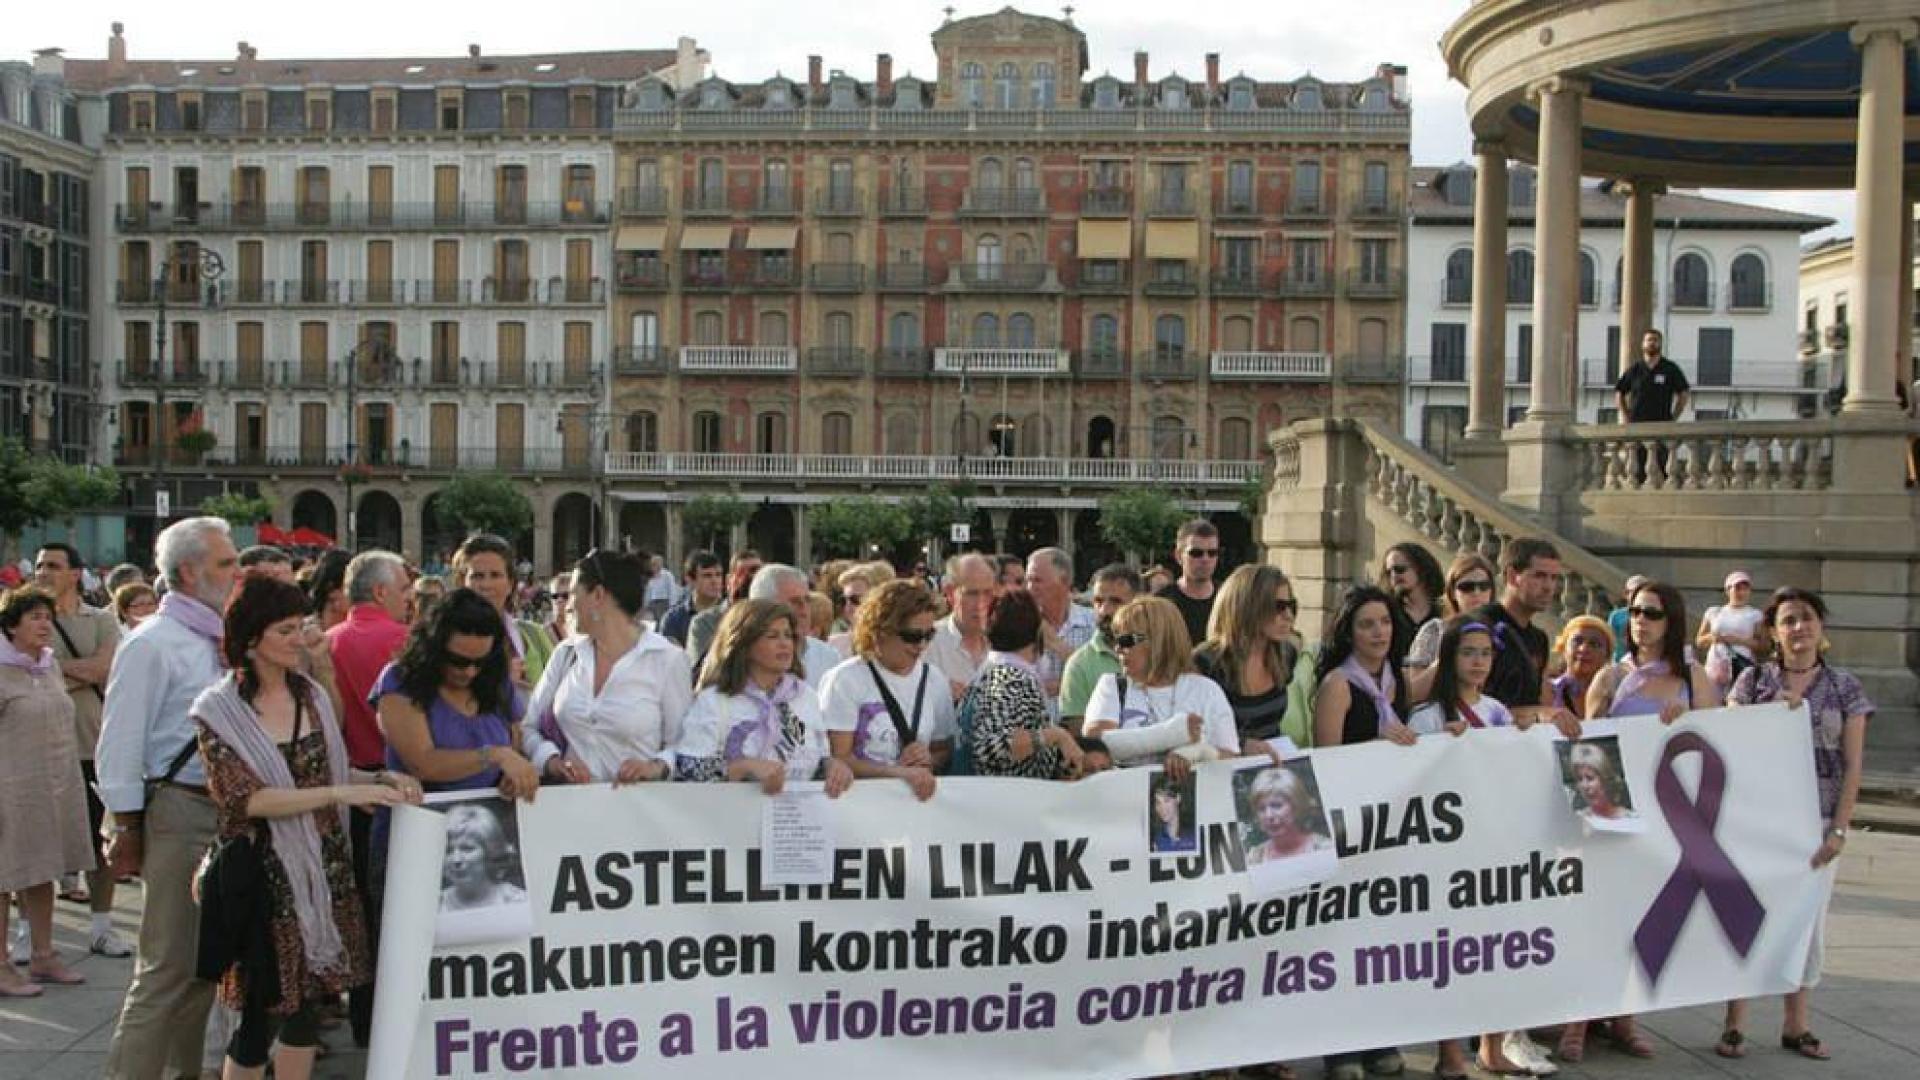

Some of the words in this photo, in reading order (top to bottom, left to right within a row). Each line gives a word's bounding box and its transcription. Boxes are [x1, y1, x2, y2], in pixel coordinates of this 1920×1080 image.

[422, 933, 777, 1001] makumeen
[798, 915, 1068, 973] kontrako
[1087, 871, 1430, 961] indarkeriaren
[1447, 850, 1585, 910] aurka
[550, 847, 906, 914] ASTELEN
[928, 837, 1094, 900] LILAK
[1109, 858, 1131, 873] -
[1330, 790, 1465, 860] LILAS
[434, 1010, 640, 1077] Frente
[658, 1013, 695, 1058] a
[716, 996, 770, 1052] la
[788, 982, 1056, 1044] violencia
[1076, 965, 1246, 1026] contra
[1261, 949, 1338, 997] las
[1354, 926, 1556, 990] mujeres
